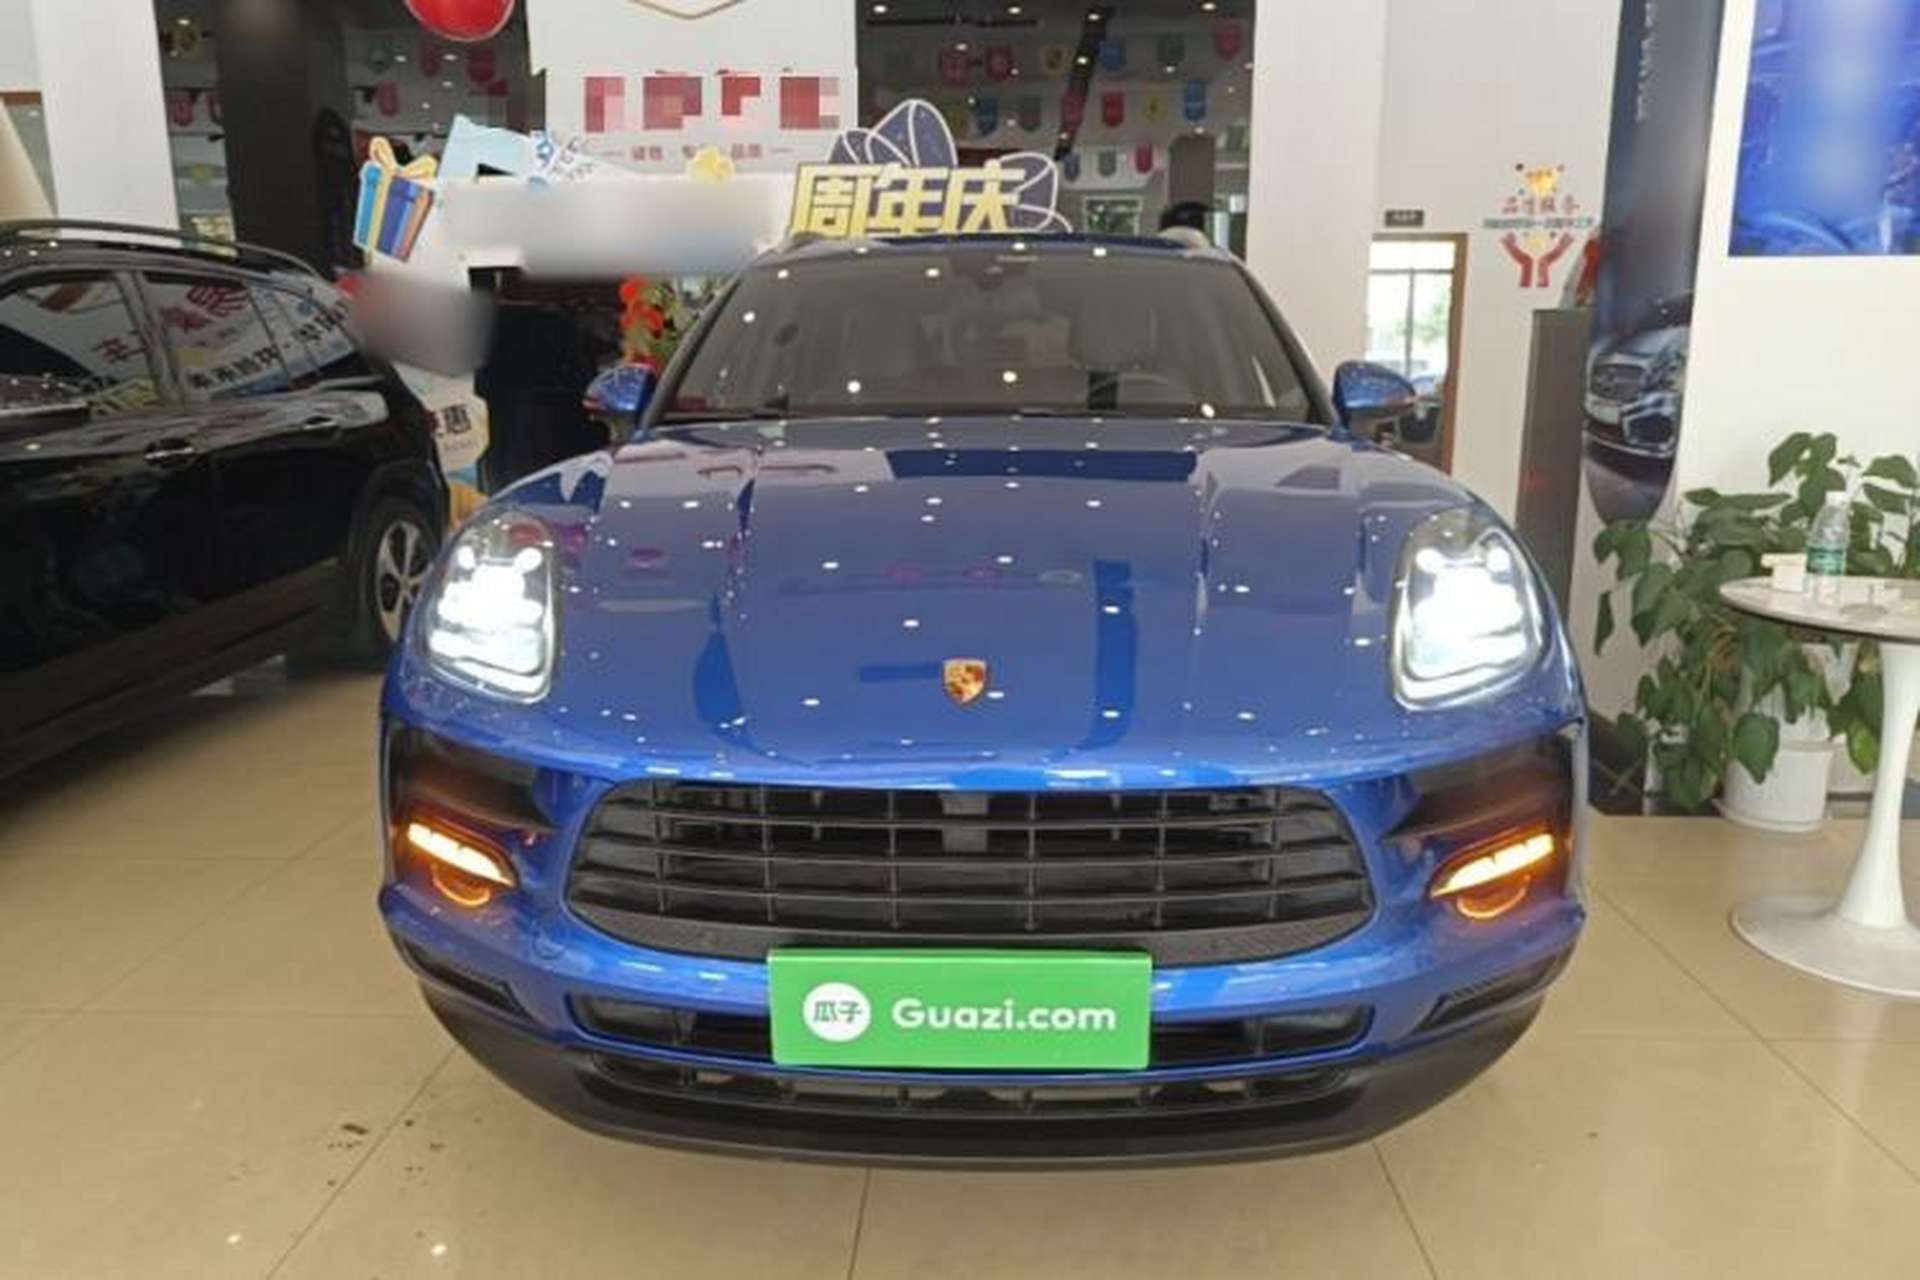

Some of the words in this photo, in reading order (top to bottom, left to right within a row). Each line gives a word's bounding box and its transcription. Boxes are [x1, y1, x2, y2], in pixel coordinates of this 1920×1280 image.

[789, 160, 1026, 238] 周年庆
[813, 1000, 863, 1023] 瓜子
[891, 997, 1117, 1032] Guazi.com
